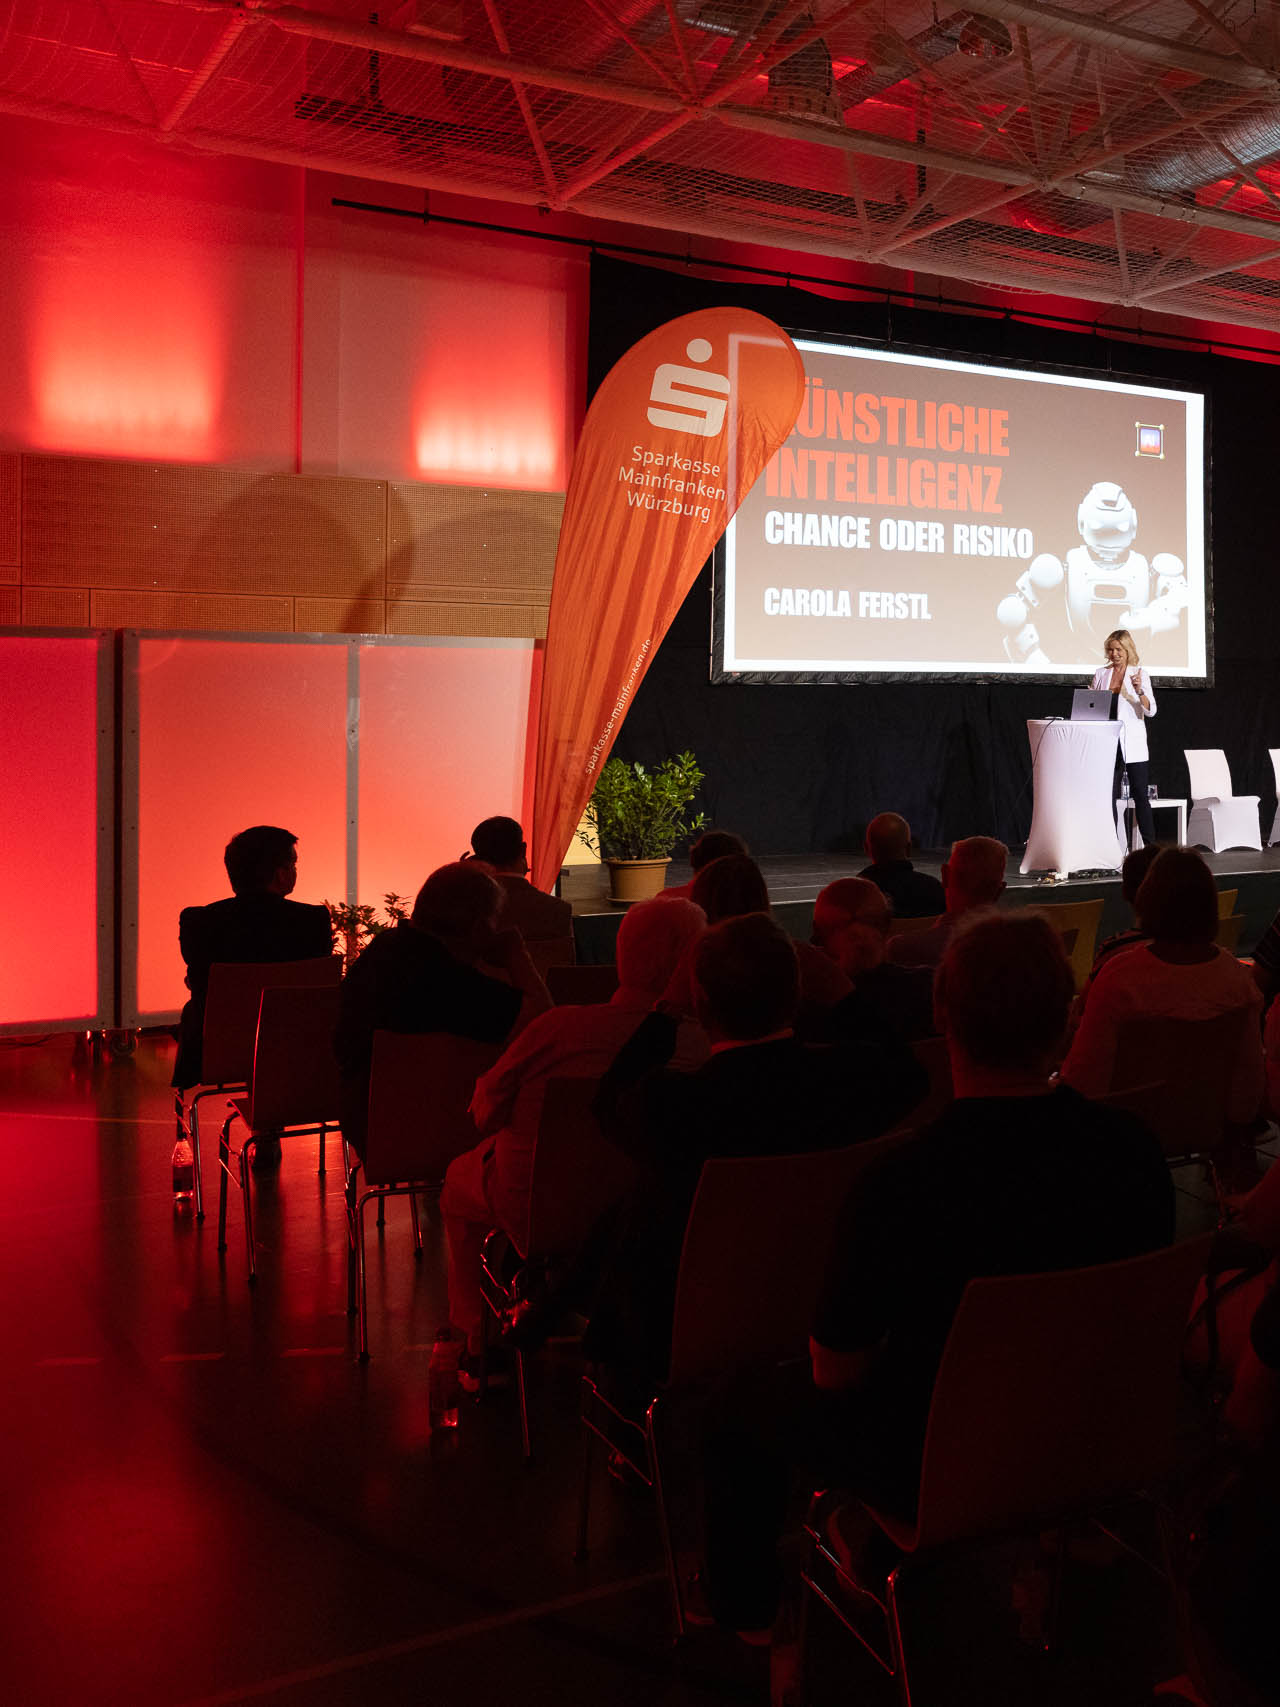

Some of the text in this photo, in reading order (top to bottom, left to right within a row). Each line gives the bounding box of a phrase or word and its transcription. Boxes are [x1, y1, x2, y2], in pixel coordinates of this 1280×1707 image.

[790, 376, 1010, 456] ÜNSTLICHE
[631, 445, 721, 478] Sparkasse
[618, 466, 726, 501] Mainfranken
[764, 447, 1003, 513] INTELLIGENZ
[627, 490, 711, 524] Würzburg
[765, 510, 1034, 559] CHANCE ODER RISIKO
[764, 587, 932, 620] CAROLA FERSTL
